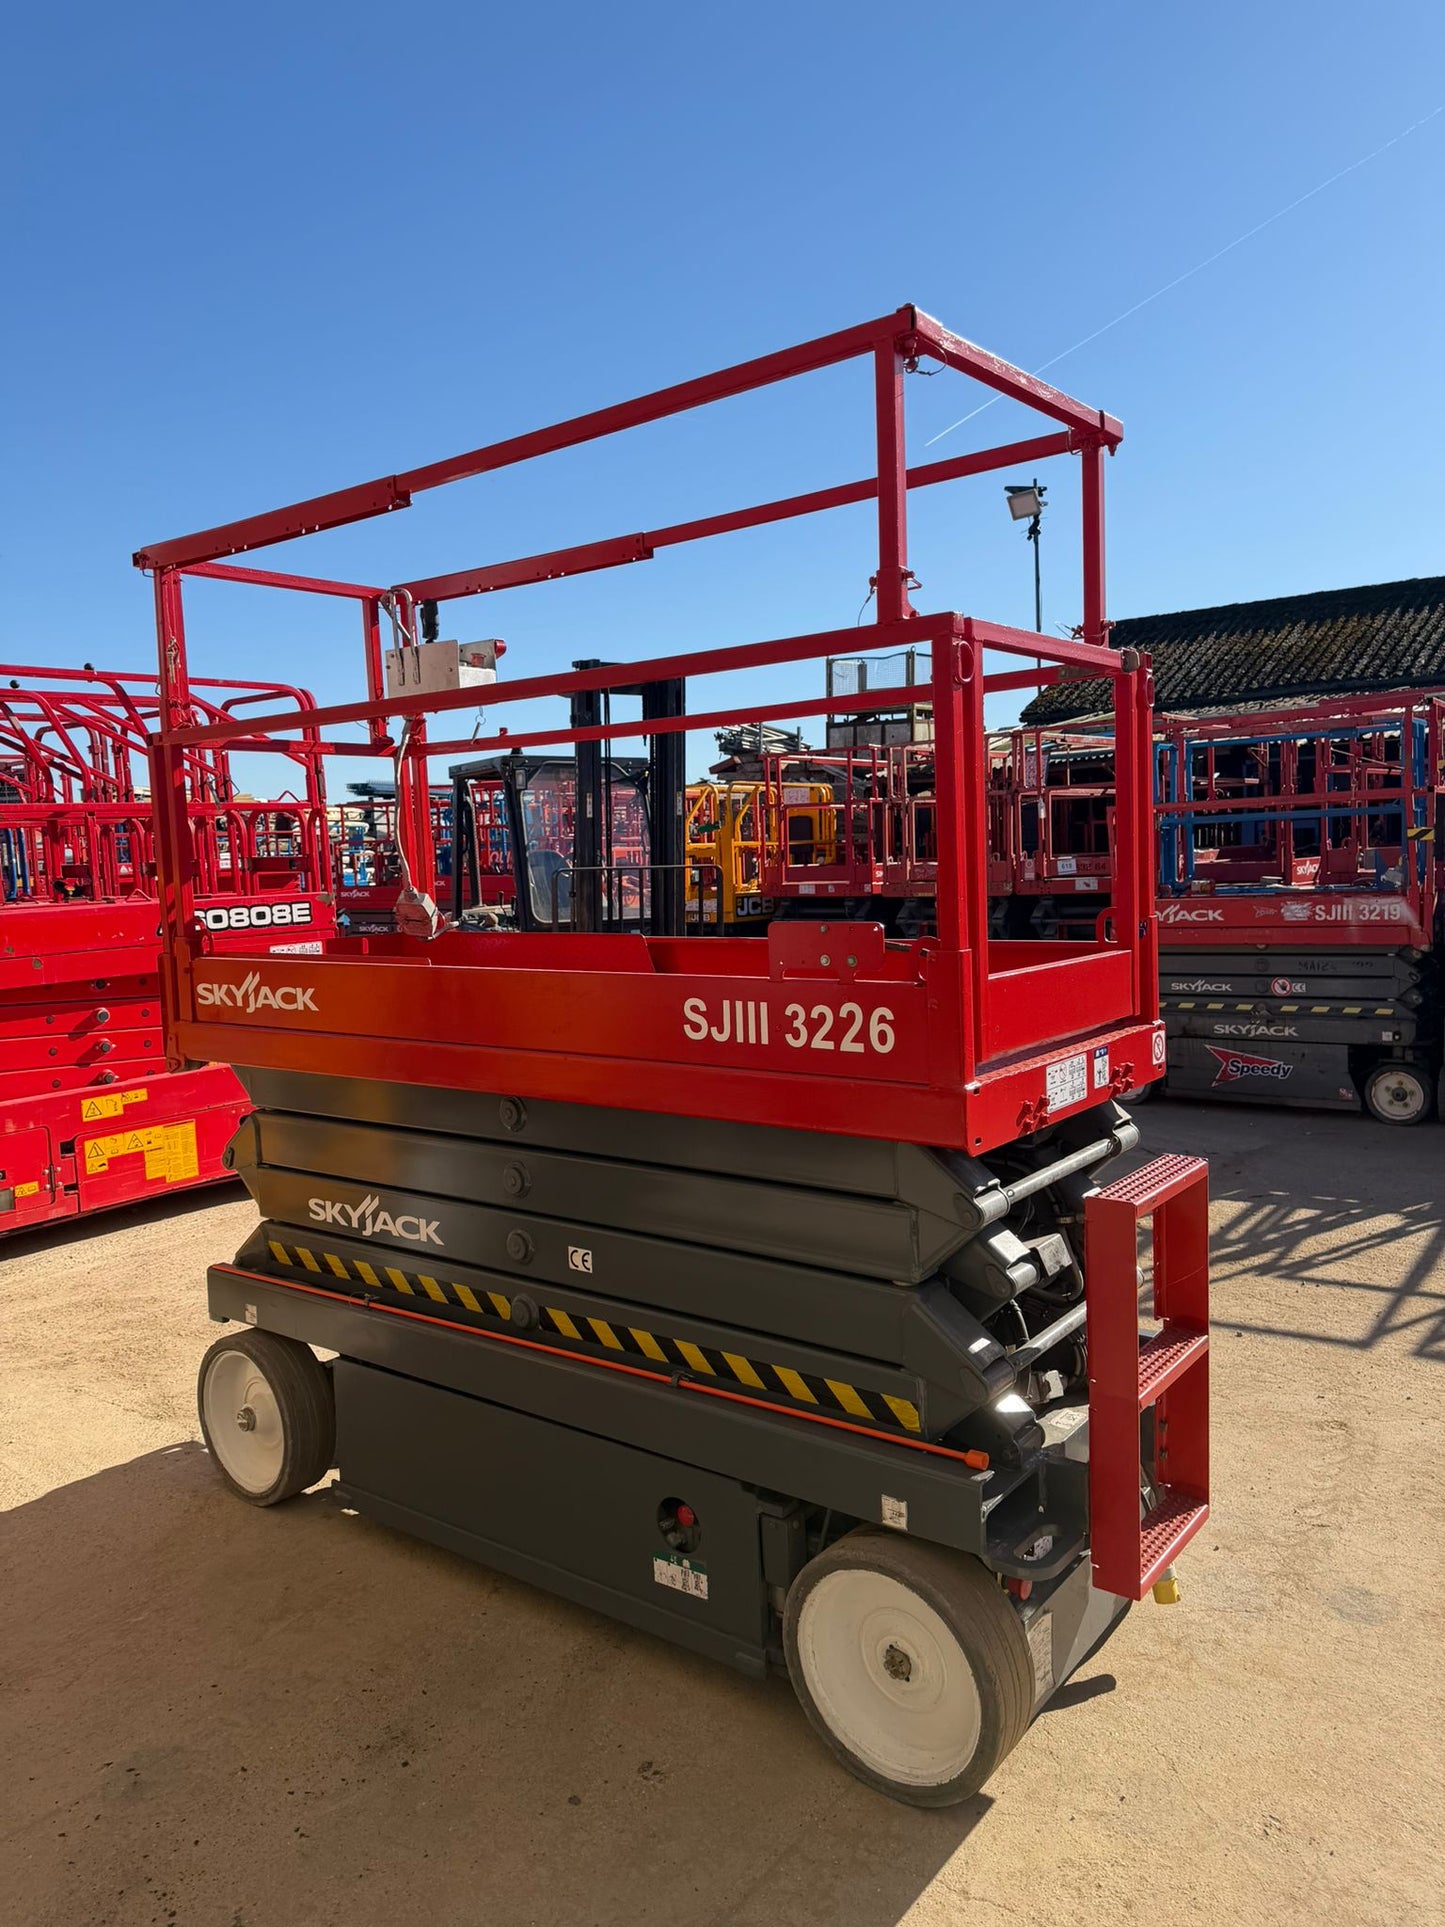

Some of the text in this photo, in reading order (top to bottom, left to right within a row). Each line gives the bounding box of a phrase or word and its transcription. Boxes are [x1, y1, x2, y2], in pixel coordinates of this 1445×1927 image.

[340, 889, 370, 898] SKYJACK
[737, 896, 775, 916] JCB
[1315, 904, 1353, 921] SJIII
[1359, 904, 1400, 921] 3219
[359, 924, 389, 932] SKYJACK
[196, 970, 319, 1013] SKYJACK
[1171, 979, 1232, 992] SKYJACK
[683, 997, 896, 1054] SJIII 3226
[1213, 1021, 1298, 1037] SKYJACK
[1227, 1059, 1294, 1079] Speedy
[308, 1194, 444, 1246] SKYJACK
[570, 1249, 591, 1271] CE
